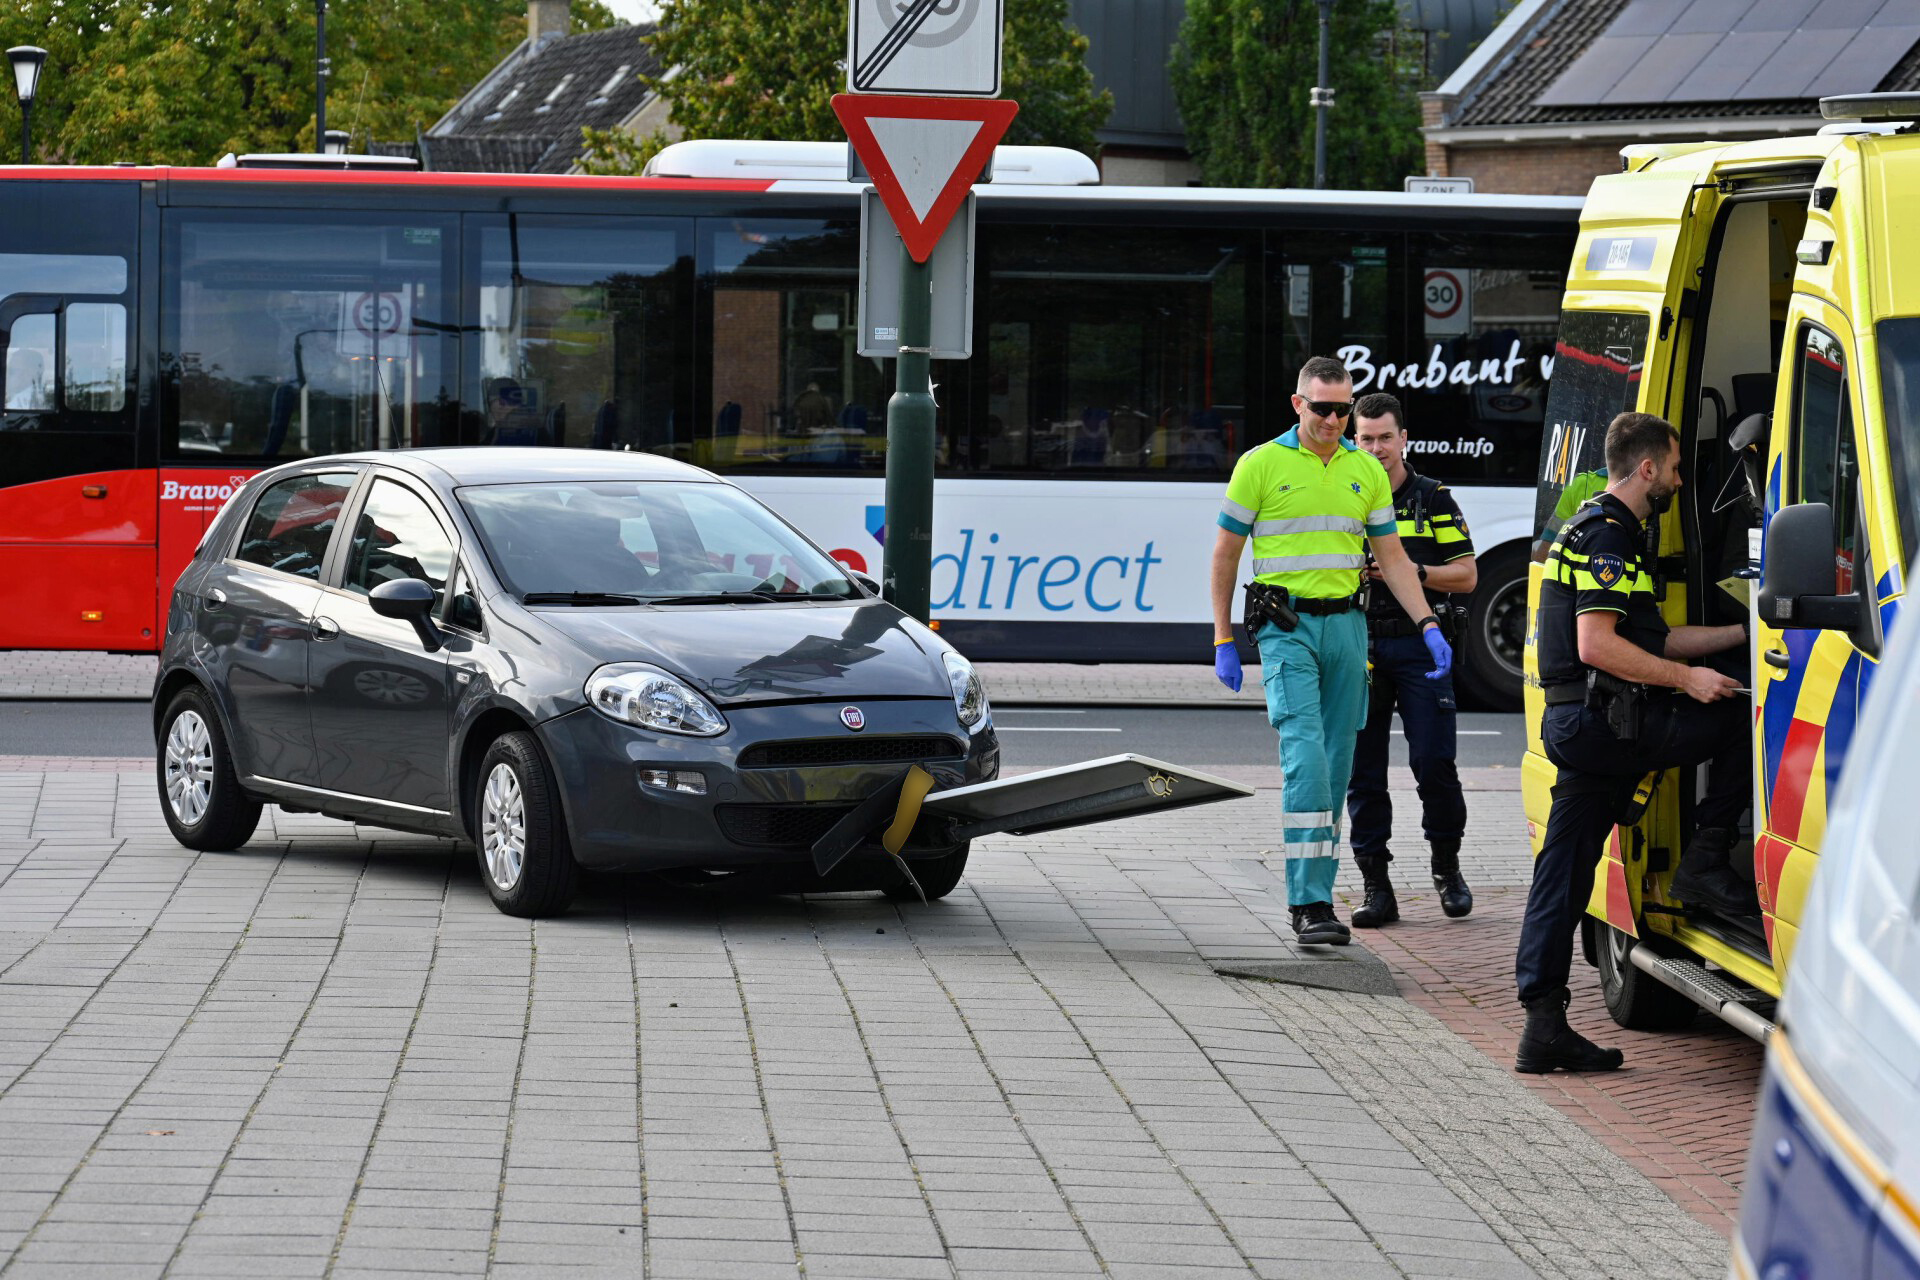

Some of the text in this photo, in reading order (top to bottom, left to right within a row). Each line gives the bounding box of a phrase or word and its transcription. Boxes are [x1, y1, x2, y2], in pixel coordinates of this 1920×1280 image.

[1427, 286, 1454, 304] 30
[363, 304, 392, 324] 30
[1337, 339, 1526, 393] Brabant
[1402, 437, 1495, 459] ravo.info
[160, 480, 232, 500] Bravo
[930, 528, 1162, 613] direct
[845, 712, 861, 723] FIAT
